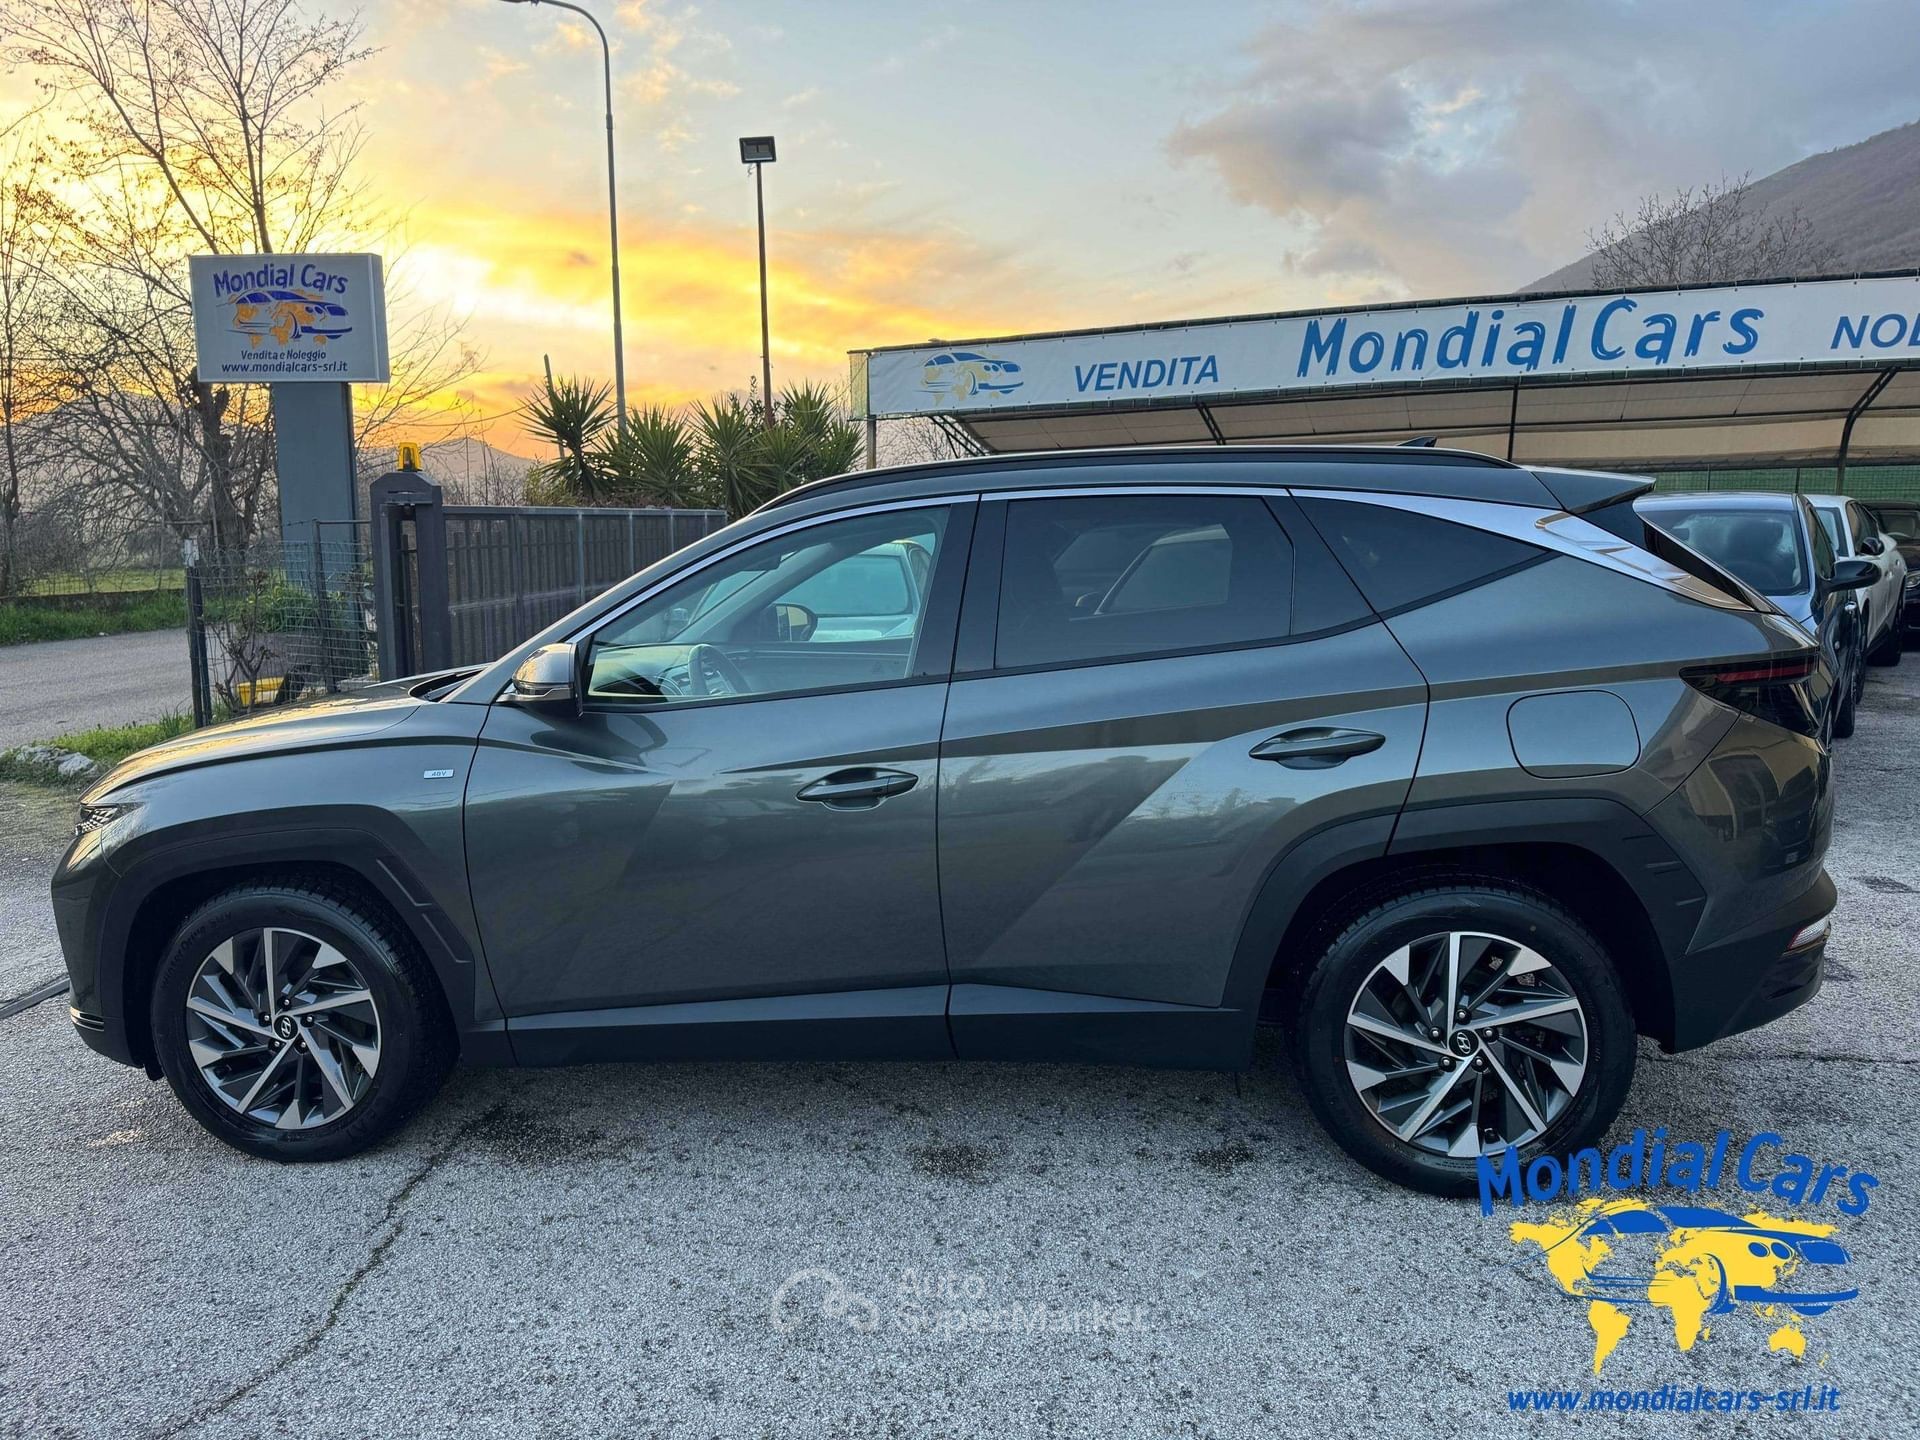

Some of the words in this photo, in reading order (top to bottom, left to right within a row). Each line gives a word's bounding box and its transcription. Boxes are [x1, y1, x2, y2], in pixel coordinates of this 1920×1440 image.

[213, 263, 295, 298] Mondial
[301, 263, 348, 294] Cars
[1296, 305, 1577, 378] Mondial
[1590, 297, 1765, 365] Cars
[221, 361, 348, 373] www.mondialcars-srl.it
[241, 349, 277, 360] Vendita
[280, 351, 286, 360] e
[286, 349, 327, 362] Noleggio
[1074, 354, 1220, 393] VENDITA
